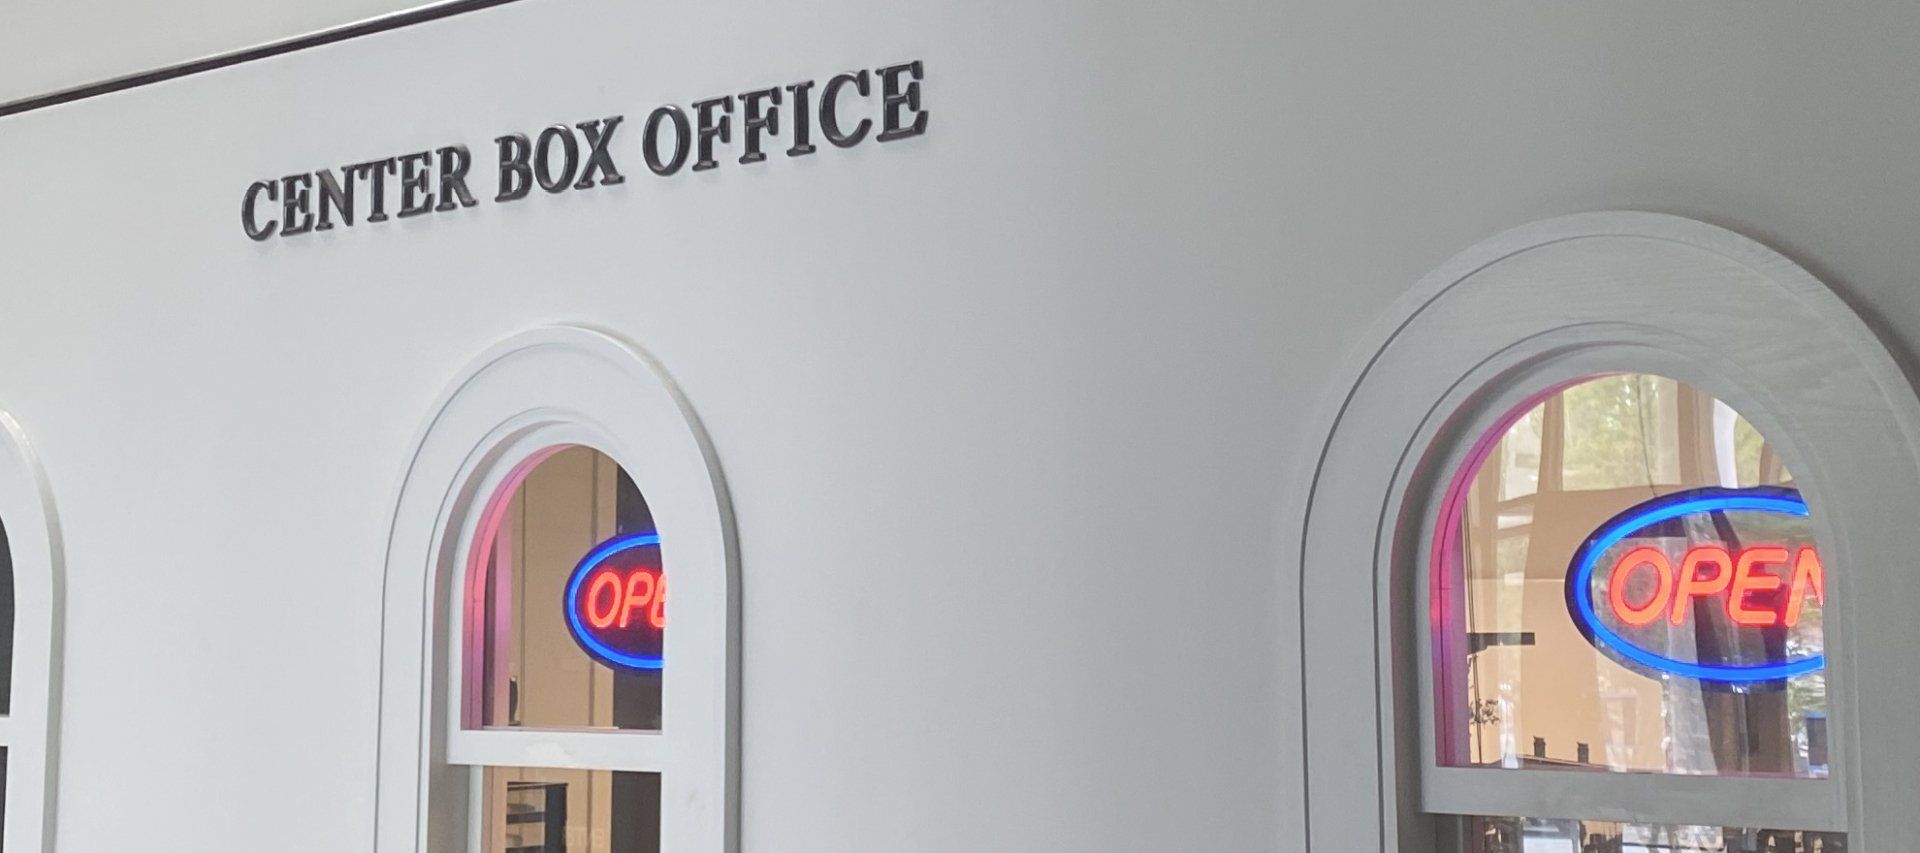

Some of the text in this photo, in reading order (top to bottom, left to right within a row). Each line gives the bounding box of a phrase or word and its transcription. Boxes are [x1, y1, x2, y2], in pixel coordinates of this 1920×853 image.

[241, 60, 929, 242] CENTER BOX OFFICE
